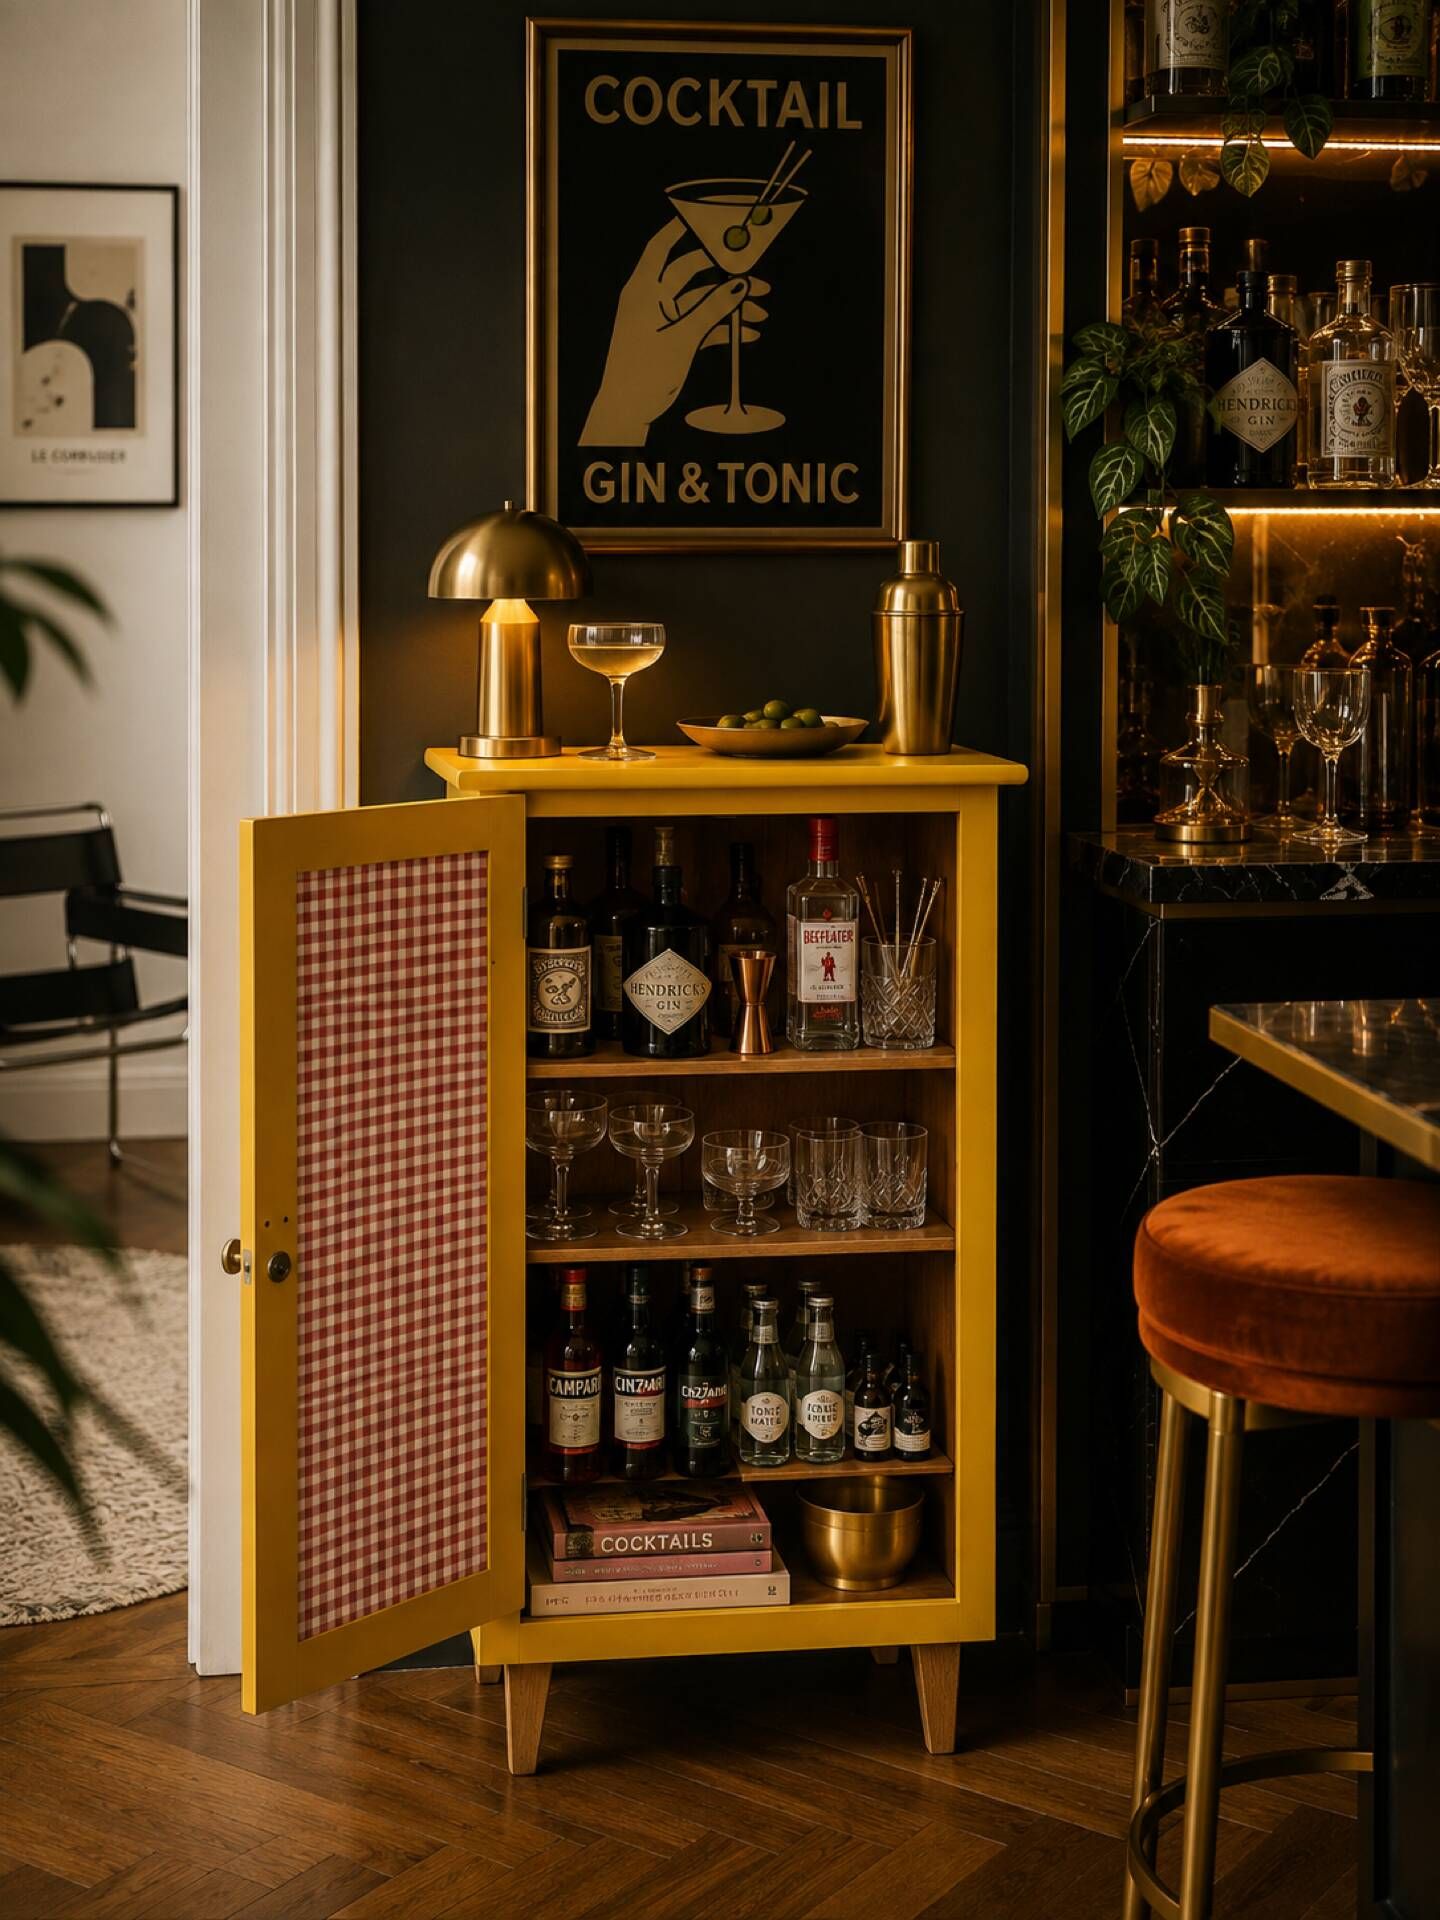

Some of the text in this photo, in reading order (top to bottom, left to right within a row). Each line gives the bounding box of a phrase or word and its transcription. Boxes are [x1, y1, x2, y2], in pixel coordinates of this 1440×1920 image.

[584, 75, 863, 130] COCKTAIL
[1247, 415, 1275, 426] GIN
[582, 461, 860, 504] GIN & TONIC
[657, 1000, 681, 1011] GIN
[601, 1533, 713, 1553] COCKTAILS
